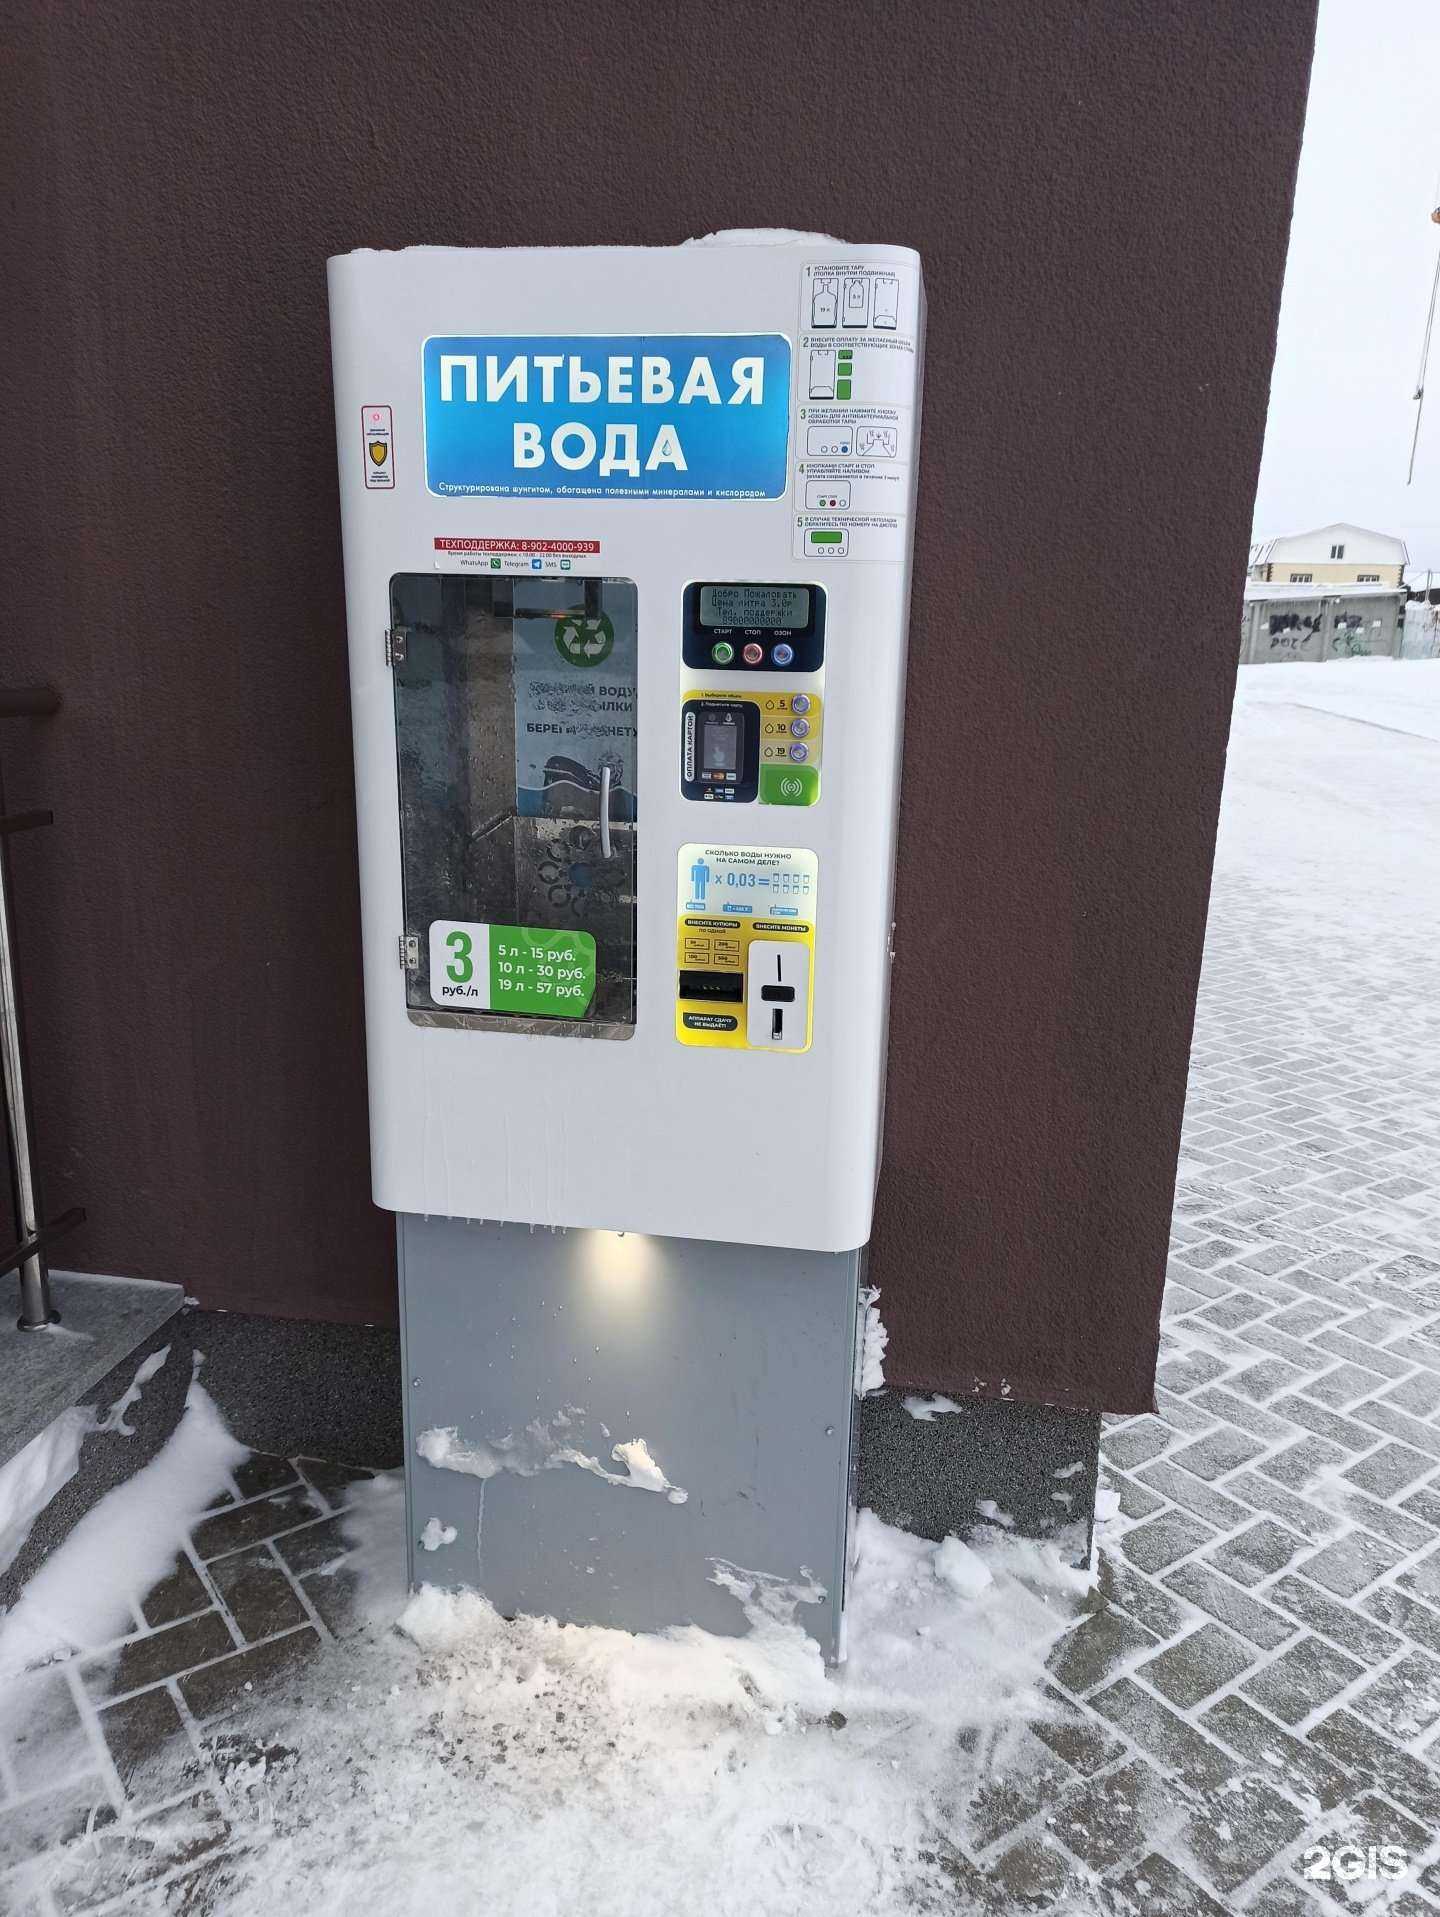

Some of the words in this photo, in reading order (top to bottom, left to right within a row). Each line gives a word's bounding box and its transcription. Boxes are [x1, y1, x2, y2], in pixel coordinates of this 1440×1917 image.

[806, 266, 811, 277] 1
[803, 337, 809, 347] 2
[440, 355, 764, 405] ПИТЬЕВАЯ
[800, 408, 806, 419] 3
[513, 421, 688, 477] ВОДА
[799, 463, 804, 474] 4
[438, 482, 510, 493] Структурирована
[513, 485, 553, 494] шунгитом,
[556, 485, 602, 495] обогащена
[605, 487, 650, 495] полезными
[652, 488, 704, 497] минералами
[715, 489, 766, 498] кислородом
[797, 517, 803, 527] 5
[439, 539, 519, 550] ТЕХПОДДЕРЖКА:
[521, 540, 595, 552] 8-902-4000-939
[504, 560, 529, 568] Telegram
[712, 588, 739, 599] Добро
[711, 598, 732, 607] Цена
[717, 607, 737, 617] Тел.
[777, 723, 786, 731] 10
[705, 849, 739, 857] СКОЛЬКО
[446, 931, 473, 983] 3
[498, 945, 506, 956] 5
[509, 947, 518, 956] л
[531, 947, 544, 959] 15
[547, 950, 576, 963] руб.
[498, 962, 513, 973] 10
[515, 965, 525, 974] л
[536, 965, 553, 976] 30
[557, 967, 586, 980] руб.
[442, 985, 478, 997] руб./л
[498, 979, 512, 990] 19
[515, 982, 524, 991] л
[536, 982, 552, 994] 57
[556, 985, 585, 998] руб.
